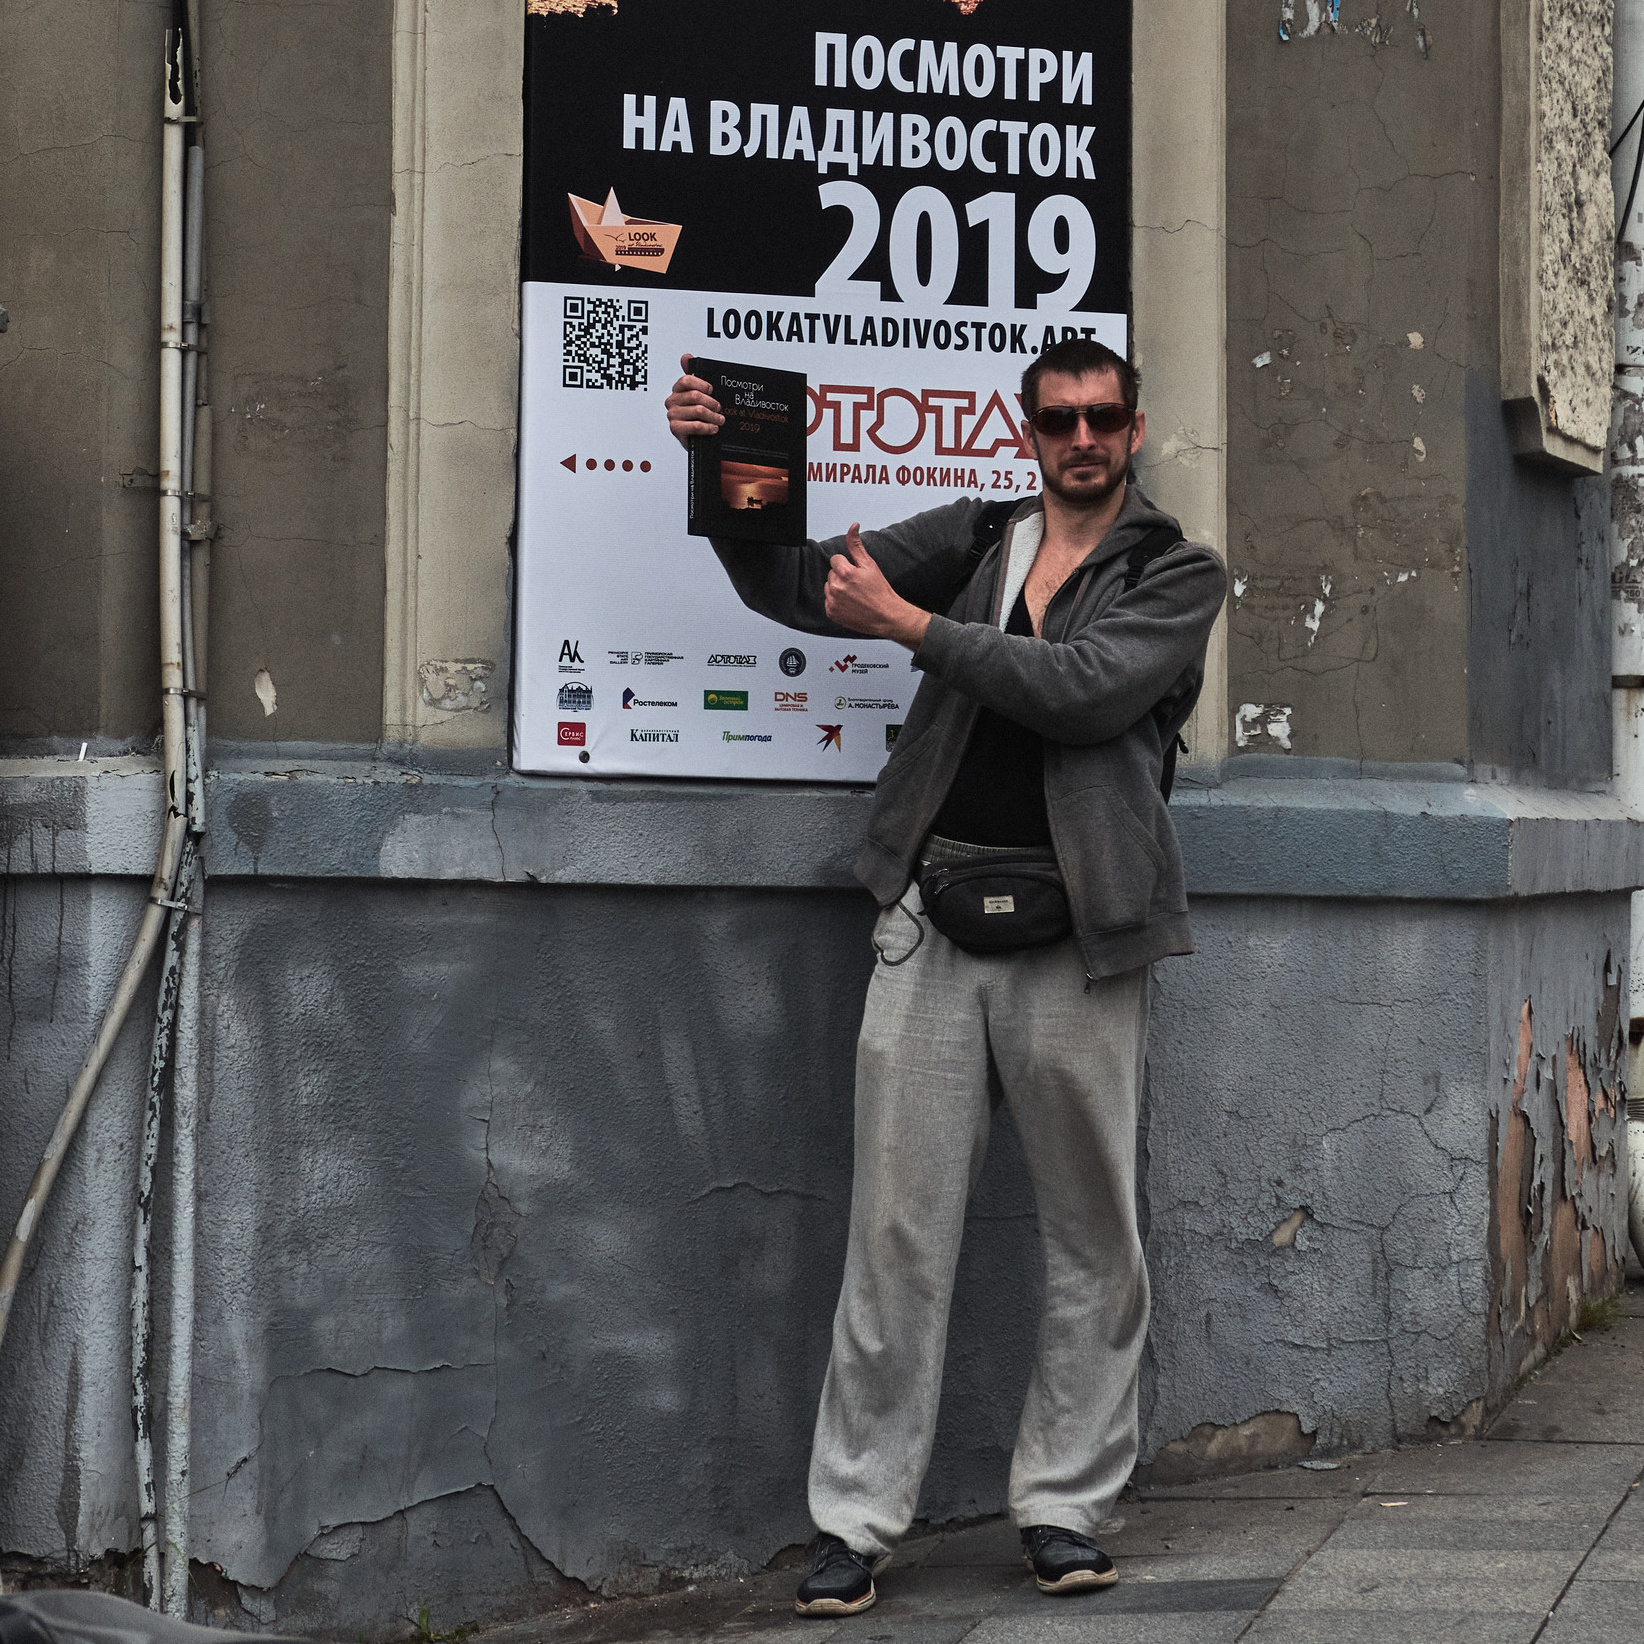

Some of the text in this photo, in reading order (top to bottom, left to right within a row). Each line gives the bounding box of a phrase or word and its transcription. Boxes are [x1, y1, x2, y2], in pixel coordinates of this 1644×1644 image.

[814, 31, 1094, 106] ПОСМОТРИ
[622, 93, 1096, 181] НА ВЛАДИВОСТОК
[628, 232, 657, 241] LOOK
[814, 179, 1097, 313] 2019
[720, 375, 764, 392] Посмотри
[735, 394, 789, 411] Владивосток
[744, 392, 755, 400] на
[722, 407, 739, 416] ook
[740, 422, 761, 433] 2019
[807, 461, 1037, 493] МИРАЛА ФОКИНА, 25, 2
[633, 698, 678, 708] Ростелеком
[774, 691, 809, 703] DNS
[855, 702, 900, 710] МОНАСТЫРЁВА
[560, 727, 584, 741] СЕРВИС
[721, 730, 773, 743] Примпогода
